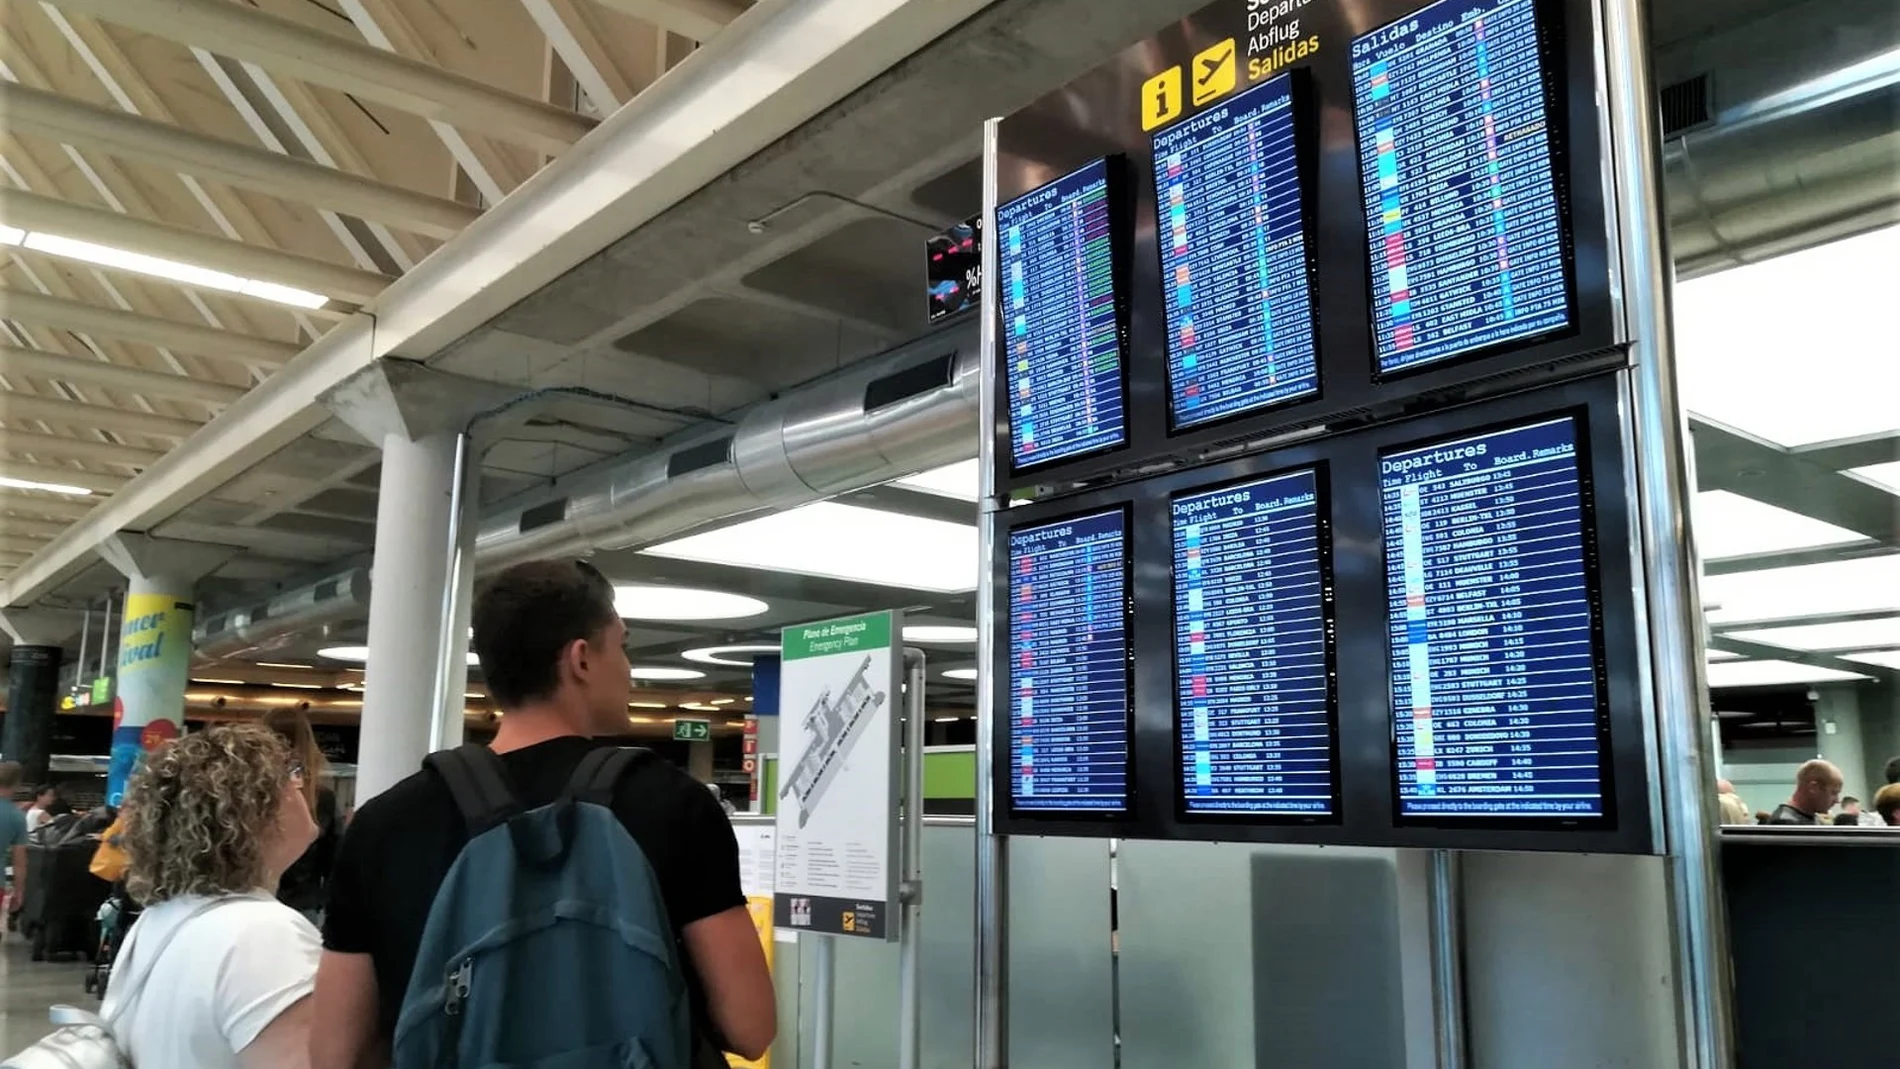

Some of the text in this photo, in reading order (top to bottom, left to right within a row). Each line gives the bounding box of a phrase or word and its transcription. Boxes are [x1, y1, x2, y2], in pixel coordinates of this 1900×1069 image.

[1247, 19, 1300, 57] Abflug
[1352, 19, 1419, 58] Salidas
[1375, 41, 1406, 60] Vuelo
[1415, 19, 1454, 43] Destino
[1248, 34, 1320, 80] Salidas
[1153, 108, 1228, 150] Departures
[1503, 119, 1545, 141] RETRASADO
[997, 187, 1057, 220] Departures
[1442, 322, 1471, 335] BELFAST
[1381, 442, 1487, 473] Departures
[1404, 468, 1442, 483] Flight
[1463, 462, 1477, 471] To
[1493, 451, 1530, 465] Board.
[1531, 442, 1574, 458] Remarks
[1172, 490, 1250, 515] Departures
[1189, 512, 1216, 523] Flight
[1232, 507, 1243, 515] To
[1011, 525, 1072, 546] Departures
[830, 620, 867, 635] Emergencia
